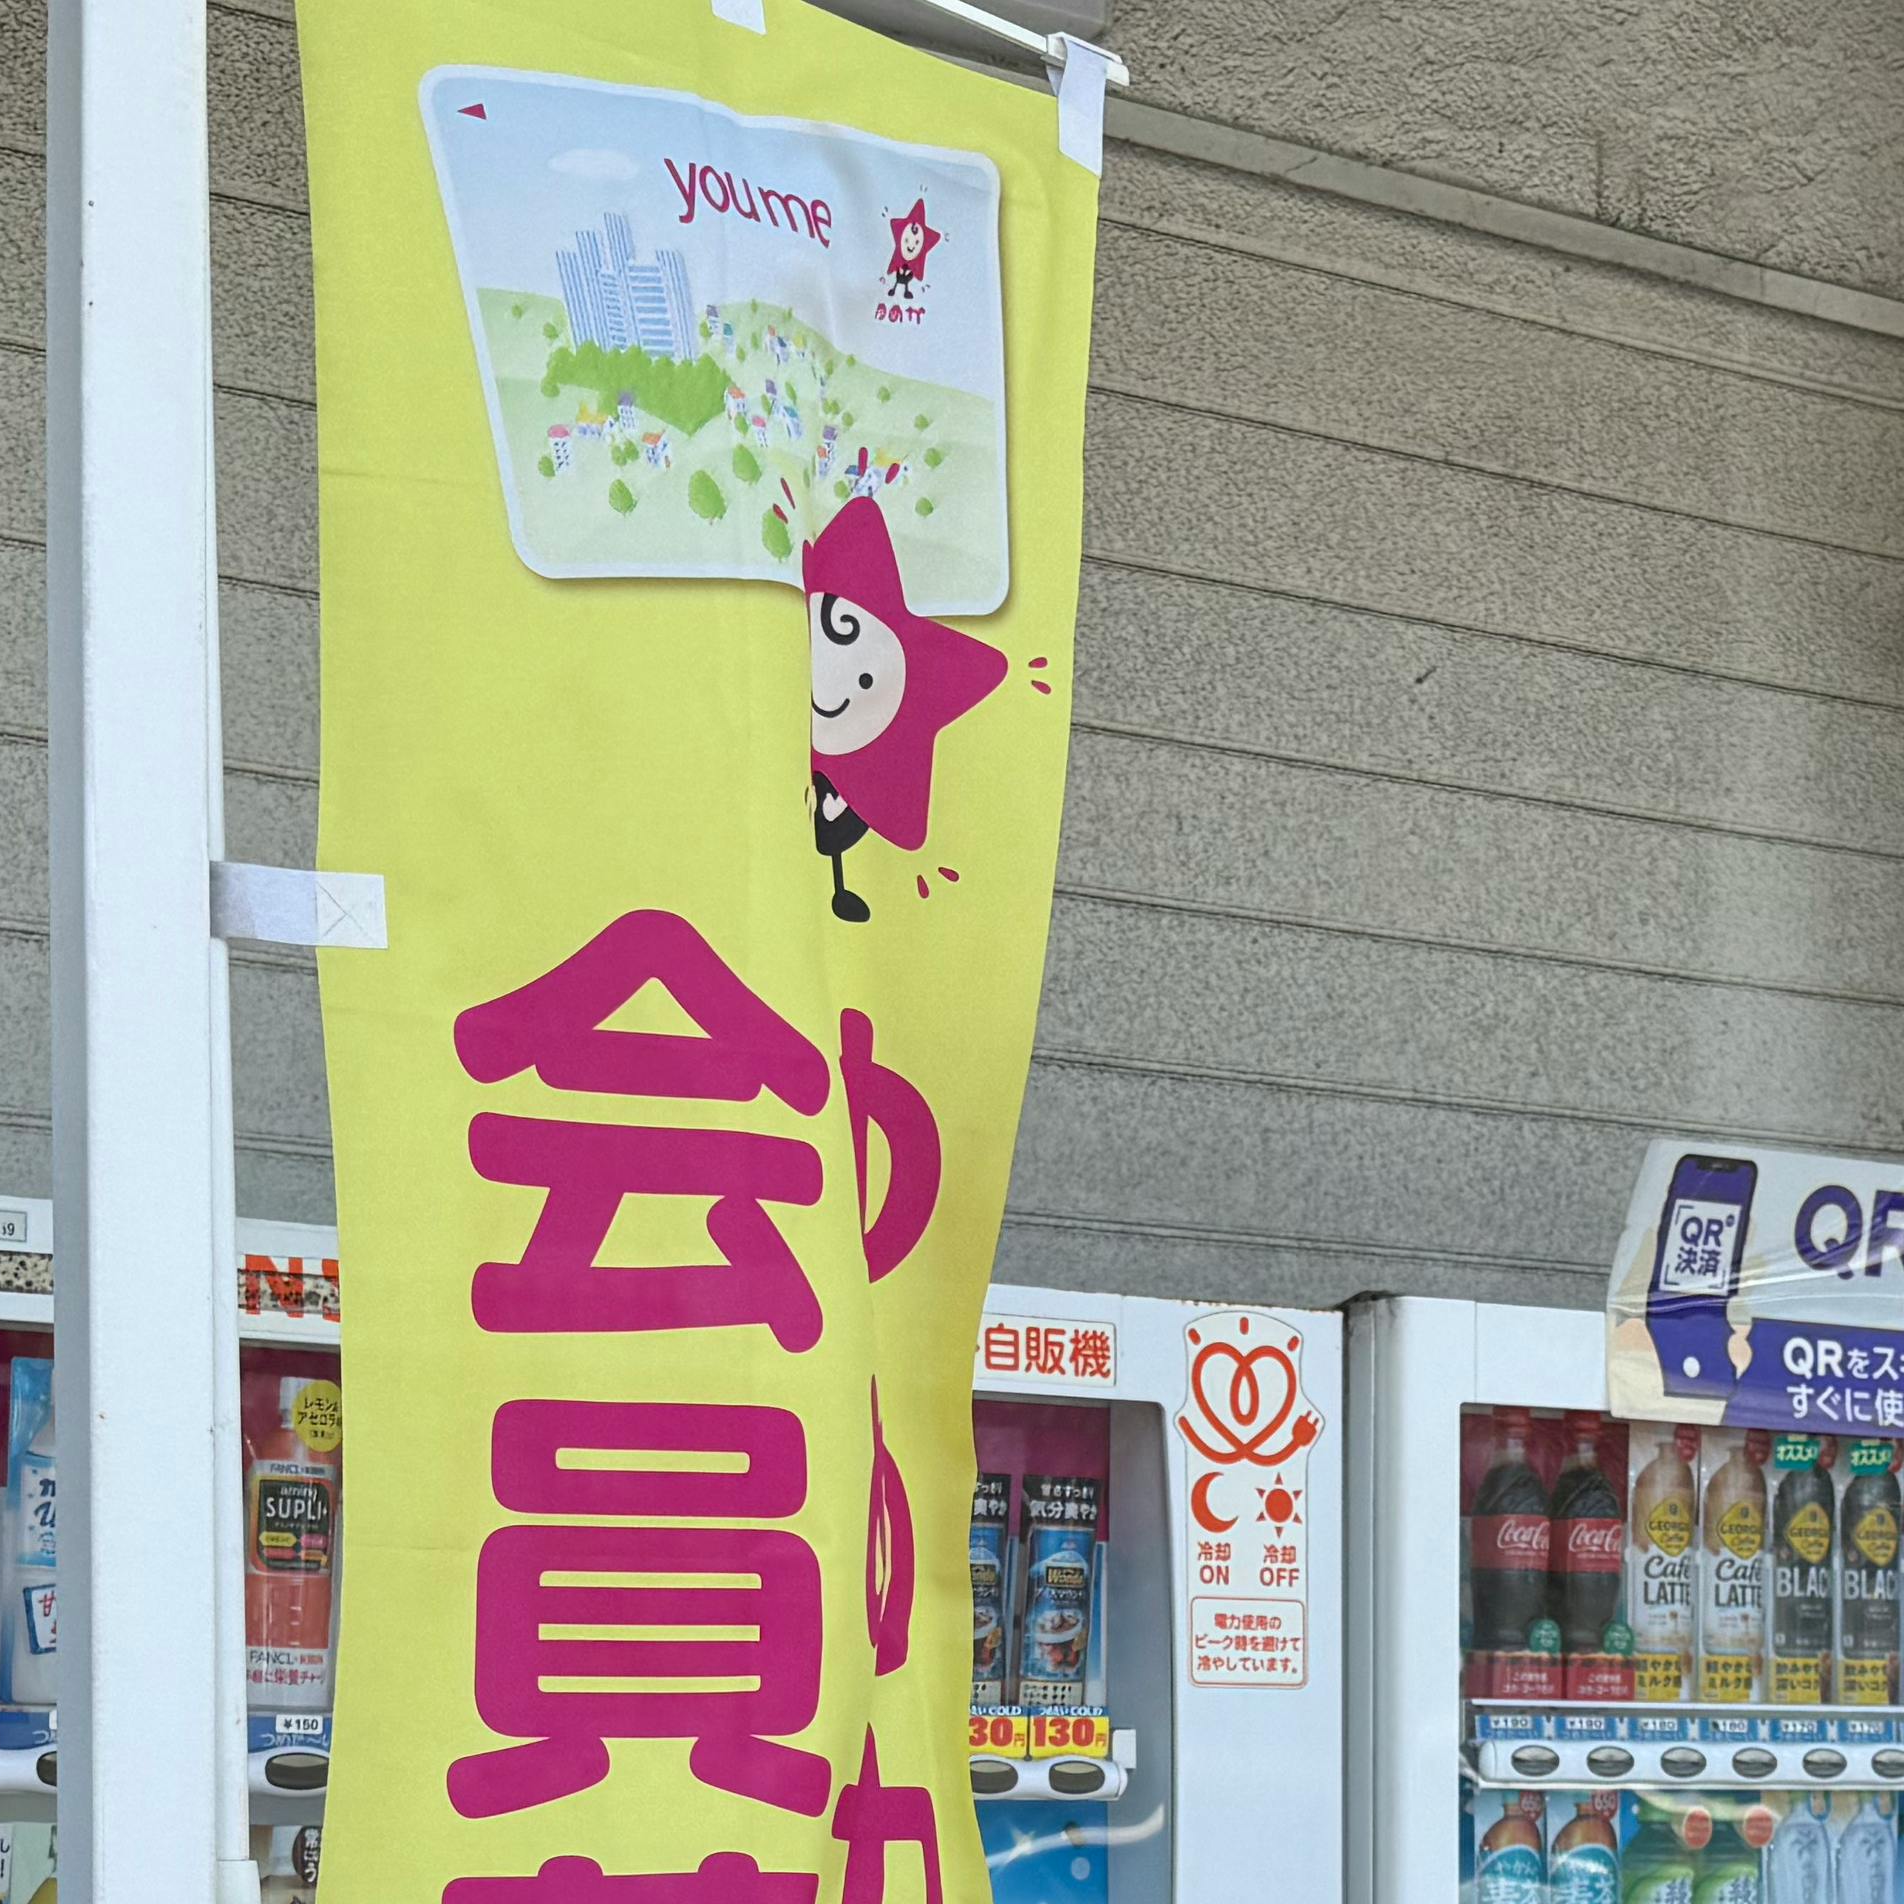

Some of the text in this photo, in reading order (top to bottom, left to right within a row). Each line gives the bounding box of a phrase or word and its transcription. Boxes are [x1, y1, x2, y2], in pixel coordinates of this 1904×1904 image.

[1680, 1215, 1724, 1249] QR
[1675, 1246, 1723, 1277] 決済
[978, 1320, 1112, 1381] 自販機
[1197, 1541, 1232, 1562] 冷却
[1263, 1544, 1297, 1565] 冷却
[1199, 1564, 1230, 1586] ON
[1259, 1566, 1301, 1588] OFF
[1776, 1566, 1829, 1600] BLAC
[1843, 1567, 1896, 1602] BLAC
[1214, 1612, 1282, 1631] 電力使用の
[1196, 1654, 1299, 1675] 冷やしています。
[969, 1716, 1025, 1748] 30円
